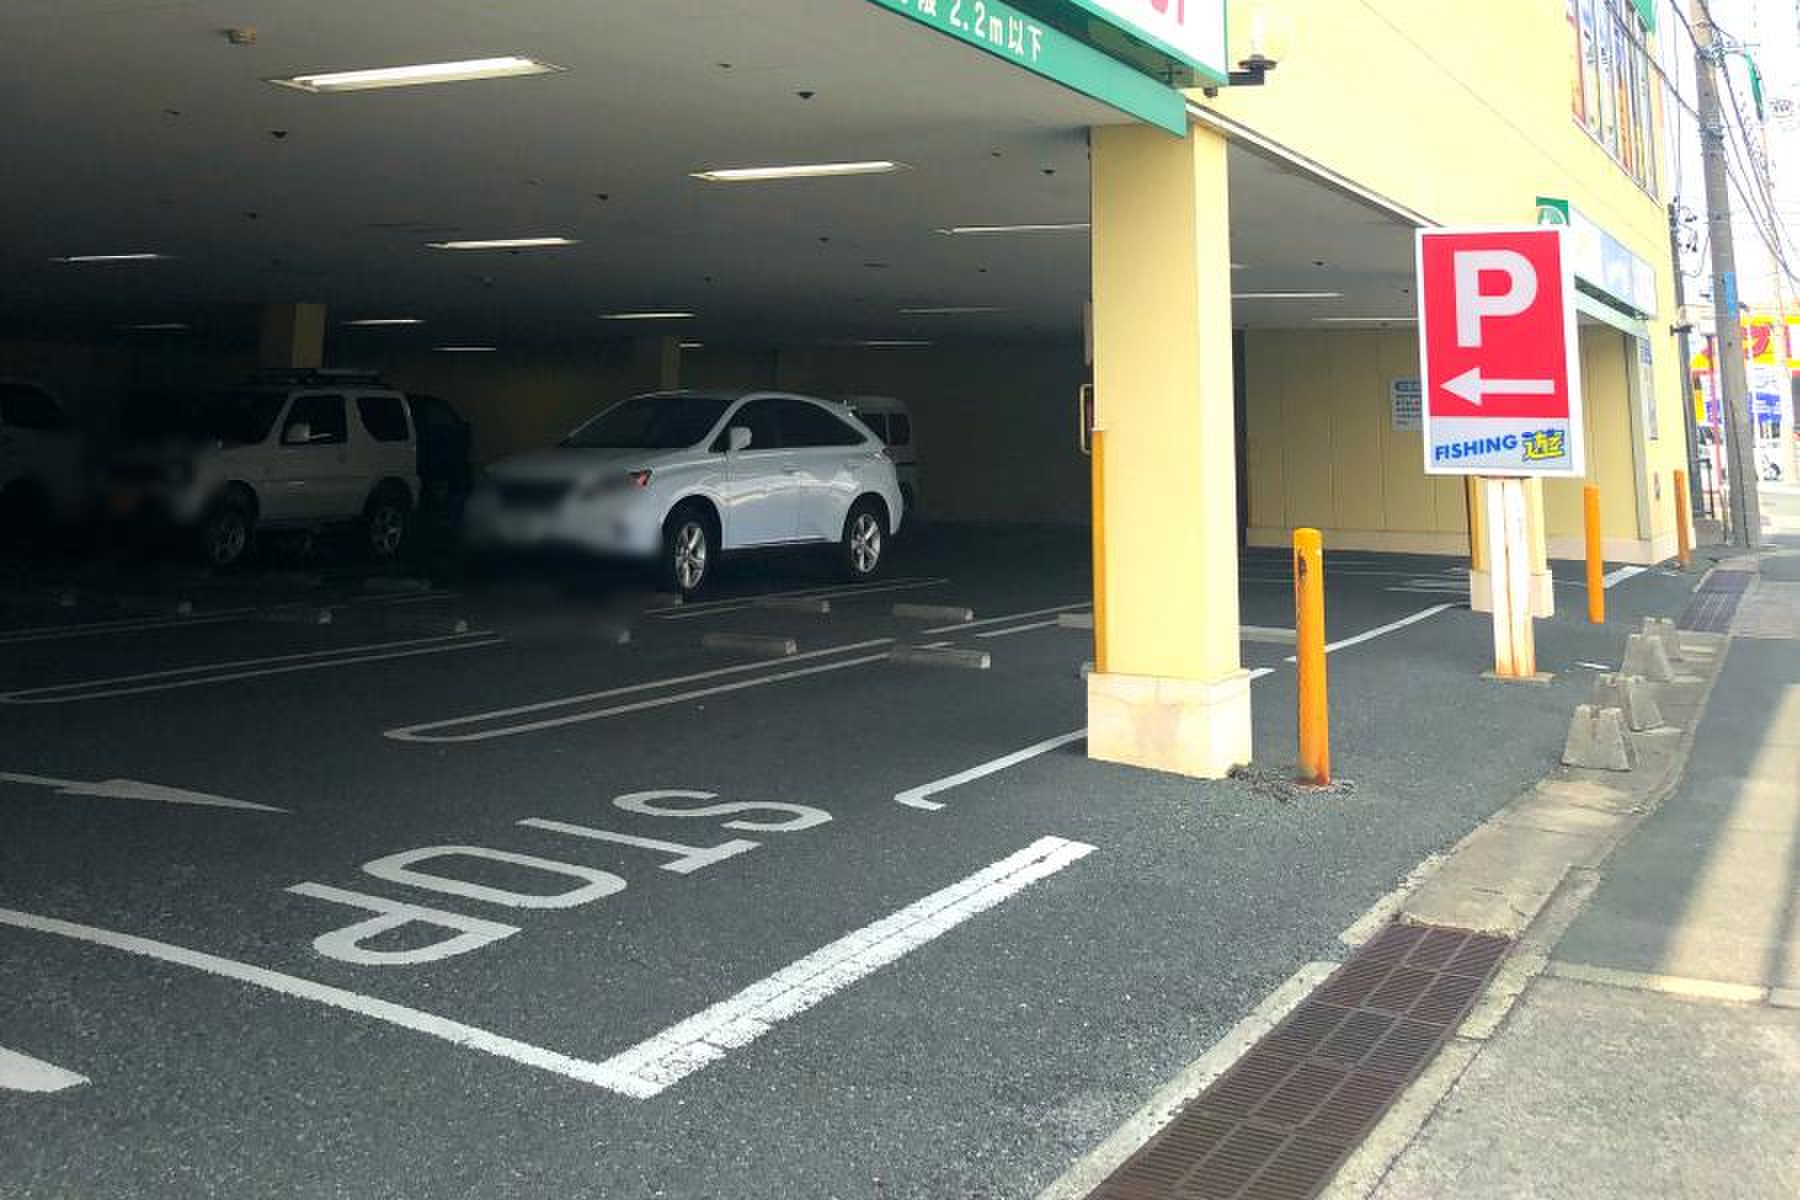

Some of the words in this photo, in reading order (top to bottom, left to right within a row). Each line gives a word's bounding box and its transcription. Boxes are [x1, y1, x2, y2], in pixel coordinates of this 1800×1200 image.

[1453, 248, 1538, 348] P
[1434, 434, 1518, 462] FISHING
[1521, 428, 1566, 462] 遊
[283, 788, 833, 966] STOP
